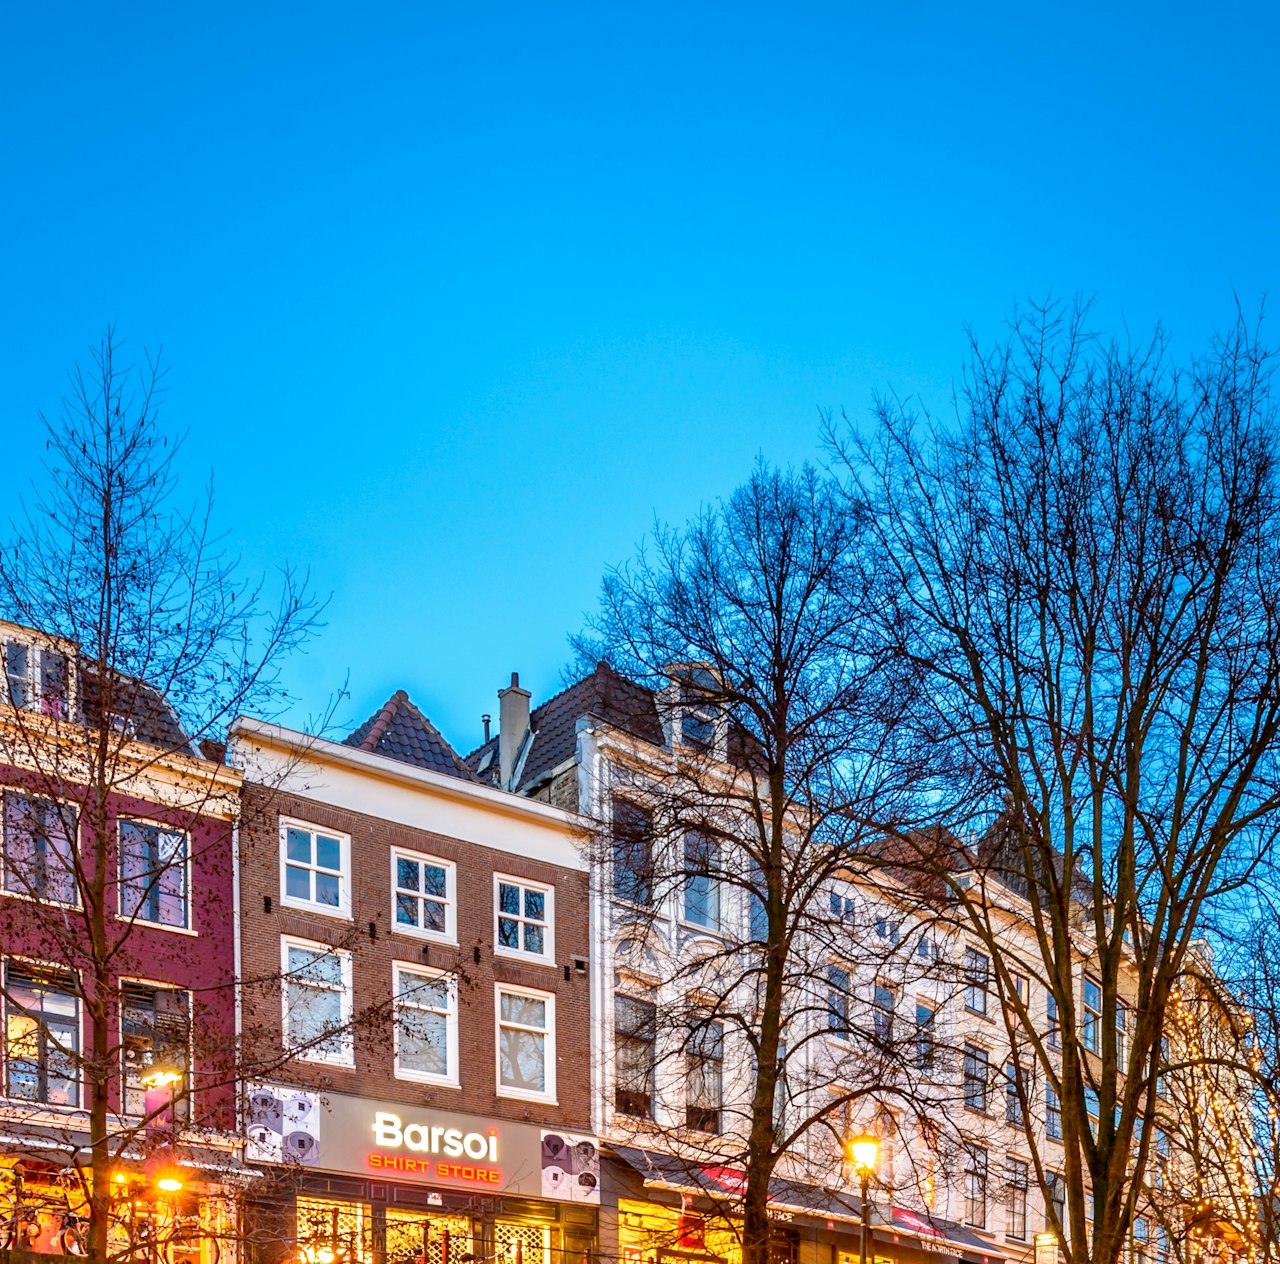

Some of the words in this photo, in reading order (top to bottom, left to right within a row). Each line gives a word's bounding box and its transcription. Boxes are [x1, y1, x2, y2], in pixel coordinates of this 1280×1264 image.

[371, 1111, 498, 1163] Barsoi
[368, 1154, 430, 1174] SHIRT
[437, 1163, 501, 1184] STORE
[921, 1241, 931, 1252] THE
[931, 1244, 950, 1256] NORTH
[949, 1248, 965, 1259] FACE
